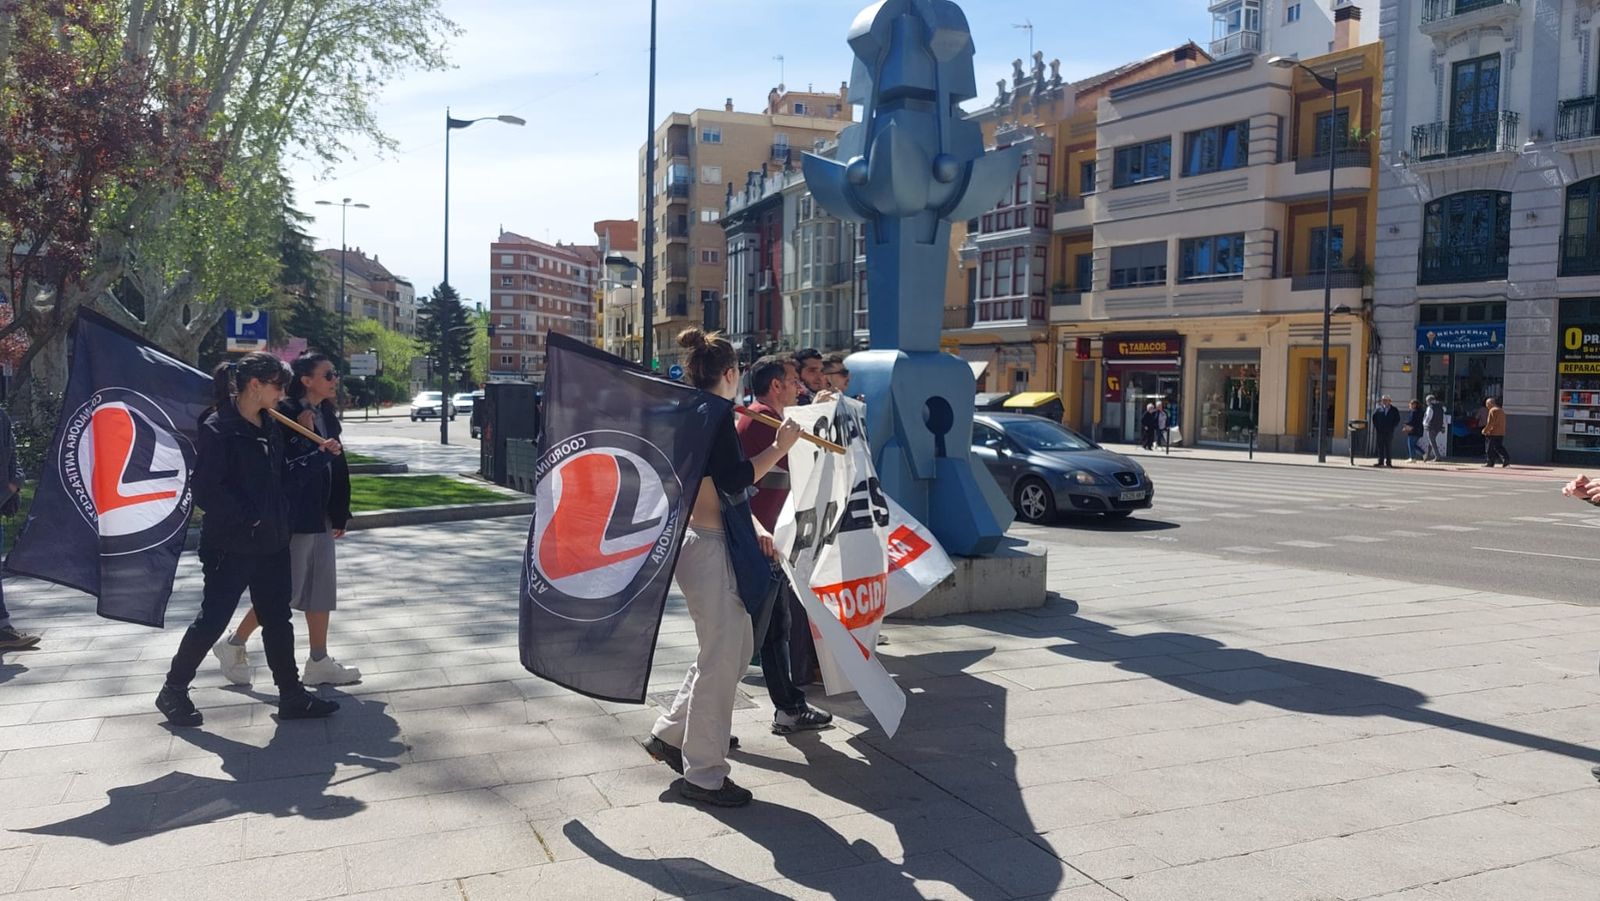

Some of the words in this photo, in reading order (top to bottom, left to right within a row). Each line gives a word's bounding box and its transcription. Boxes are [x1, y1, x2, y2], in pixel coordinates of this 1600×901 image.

[235, 305, 260, 335] P
[1584, 334, 1600, 344] PR
[1129, 342, 1167, 352] TABACOS
